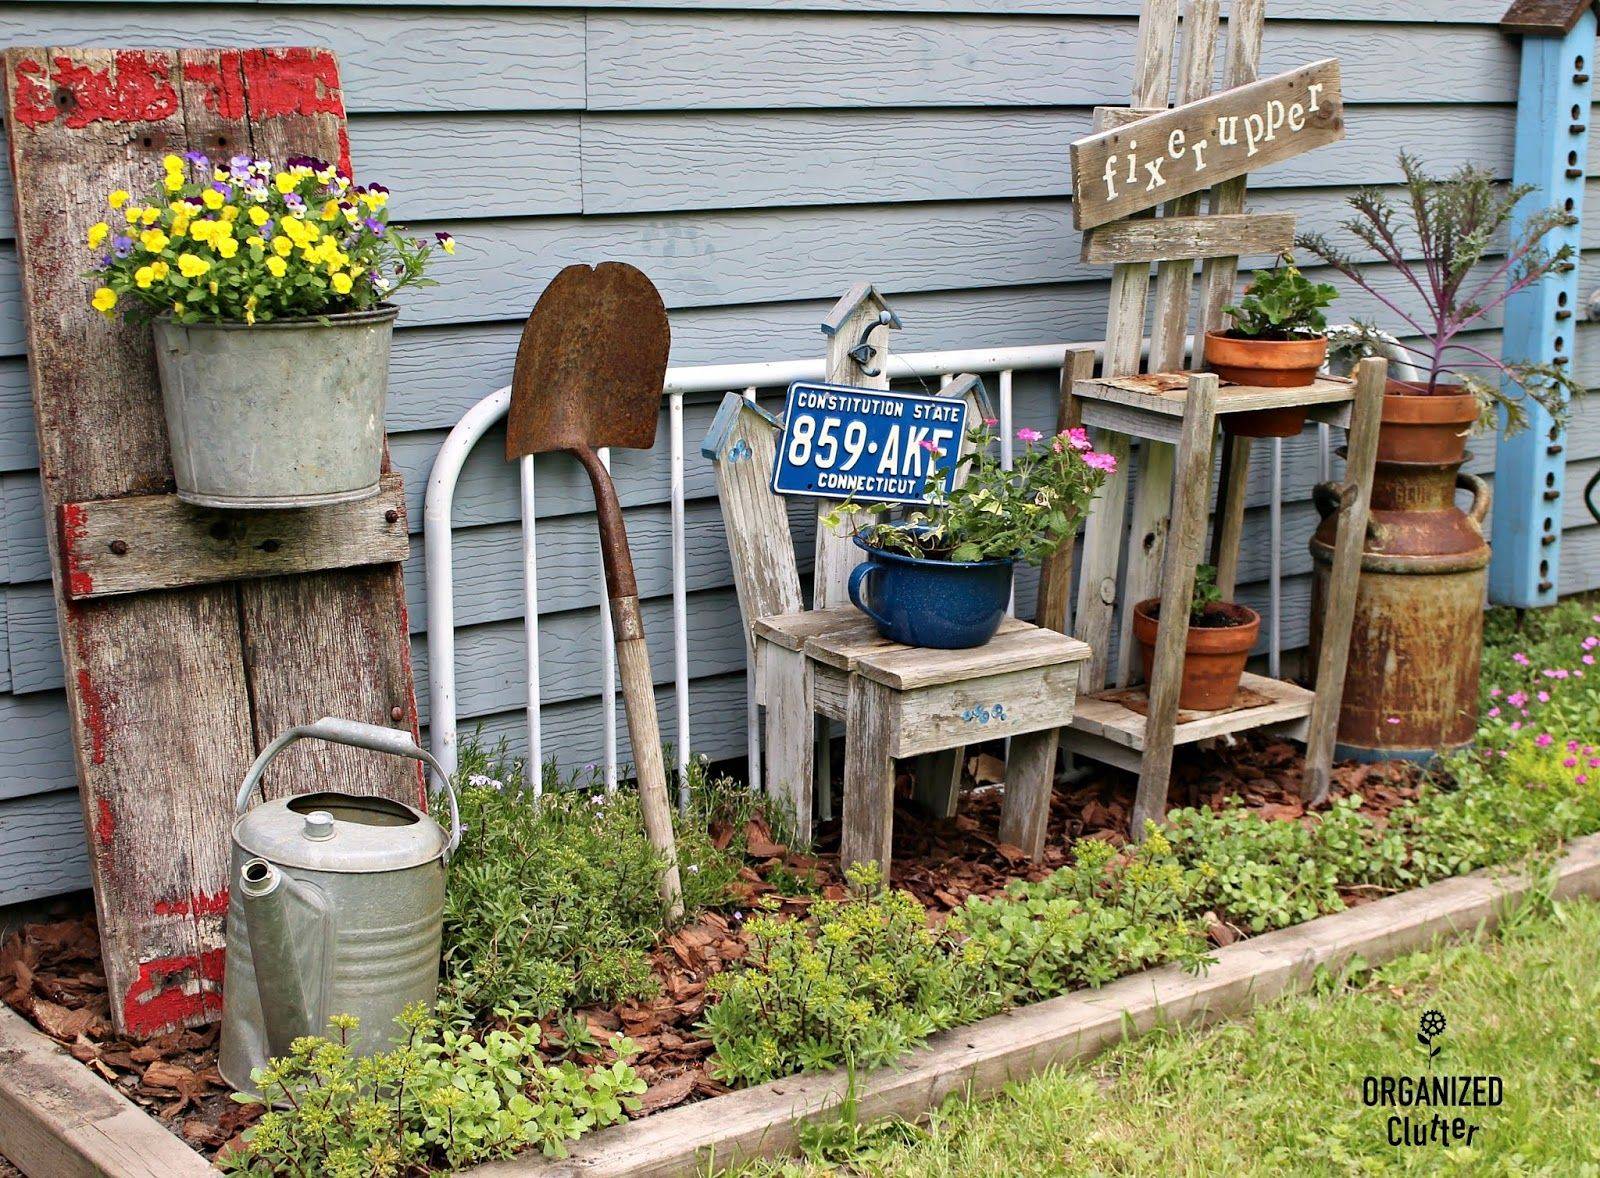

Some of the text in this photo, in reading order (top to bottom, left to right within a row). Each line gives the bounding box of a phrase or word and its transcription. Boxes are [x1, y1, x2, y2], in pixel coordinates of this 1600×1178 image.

[1102, 81, 1323, 202] fixer upper
[798, 391, 961, 422] CONSTITUTION STATE
[817, 472, 916, 494] CONNECTICUT
